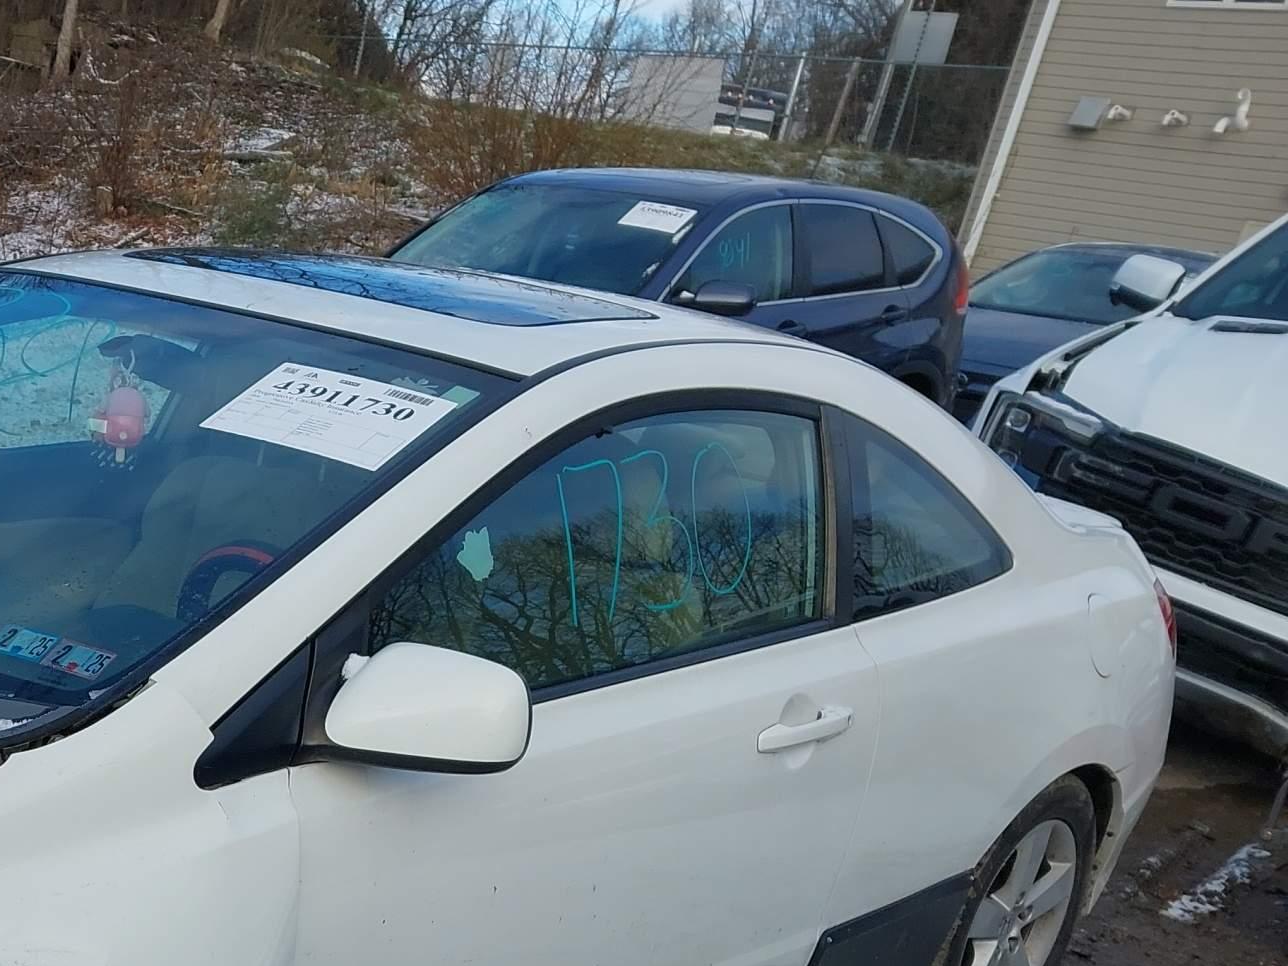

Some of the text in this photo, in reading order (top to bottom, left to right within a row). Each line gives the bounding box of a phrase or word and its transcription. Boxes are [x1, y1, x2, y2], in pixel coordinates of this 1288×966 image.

[272, 380, 415, 422] 43911730
[28, 637, 54, 657] 25
[51, 645, 112, 675] 2 25
